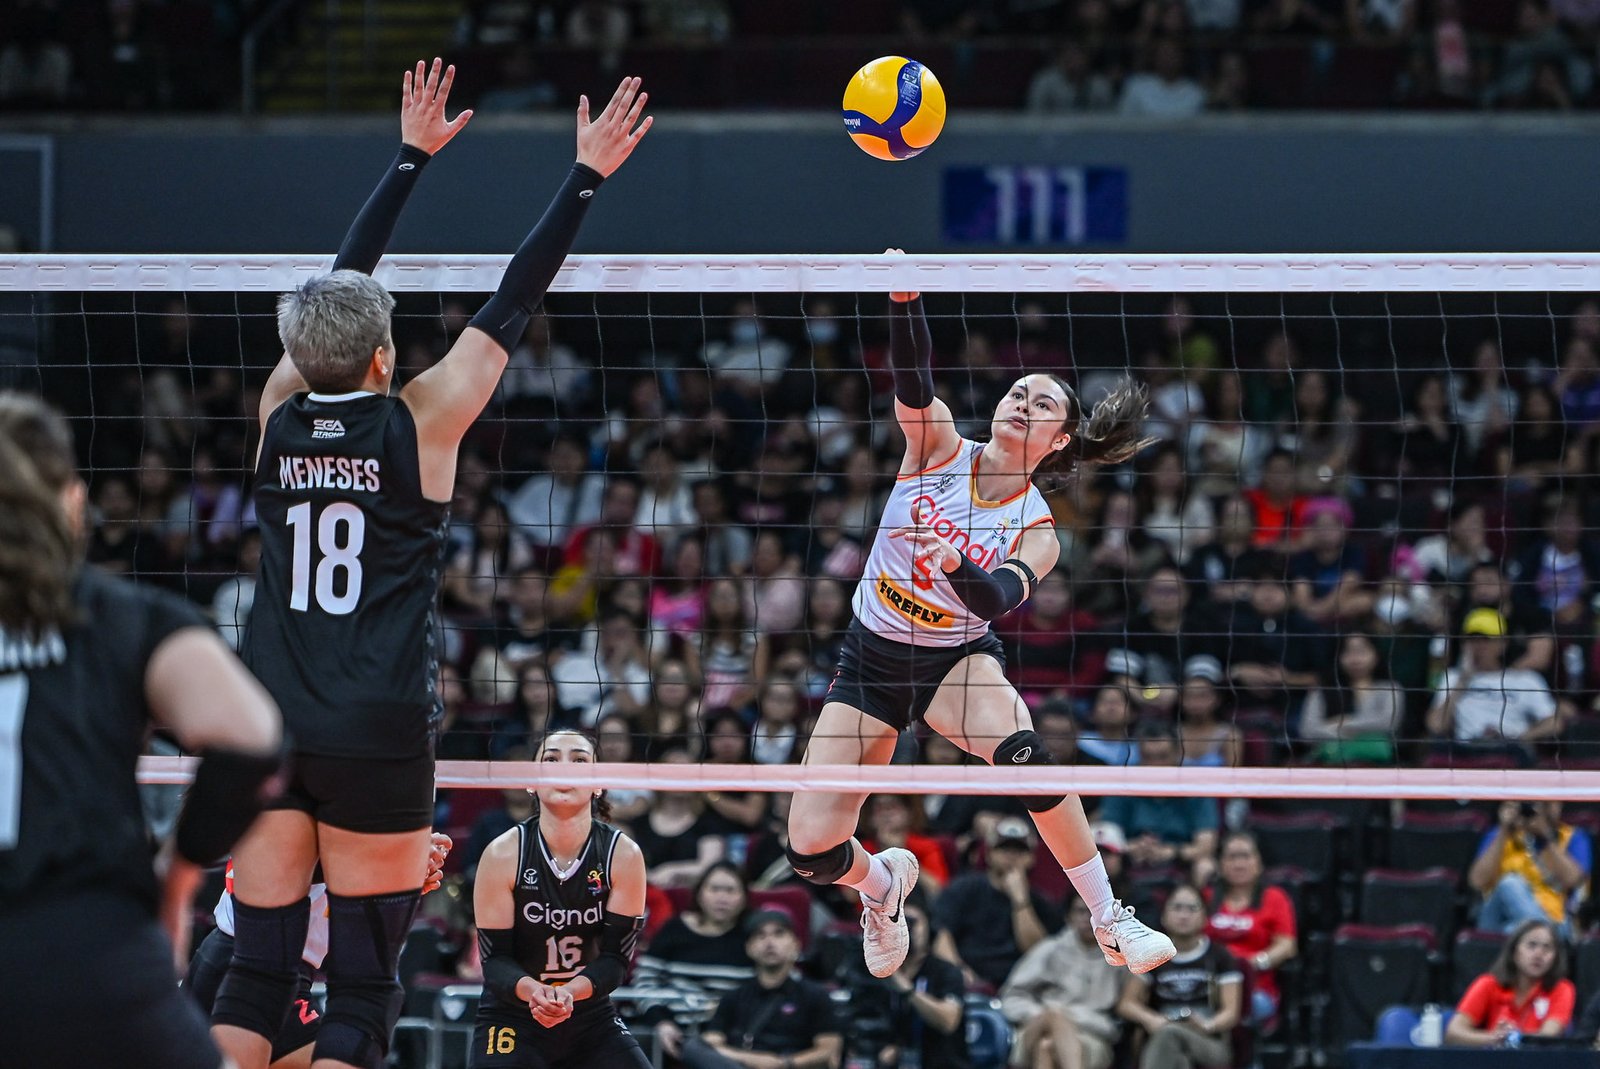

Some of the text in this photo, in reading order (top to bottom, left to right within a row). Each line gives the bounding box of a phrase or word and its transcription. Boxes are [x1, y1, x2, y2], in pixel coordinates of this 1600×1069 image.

[985, 166, 1086, 245] 111
[279, 456, 380, 492] MENESES
[286, 501, 365, 615] 18
[879, 580, 944, 623] FIREFLY
[523, 901, 603, 930] Cignal
[545, 935, 583, 970] 16
[486, 1026, 516, 1055] 16
